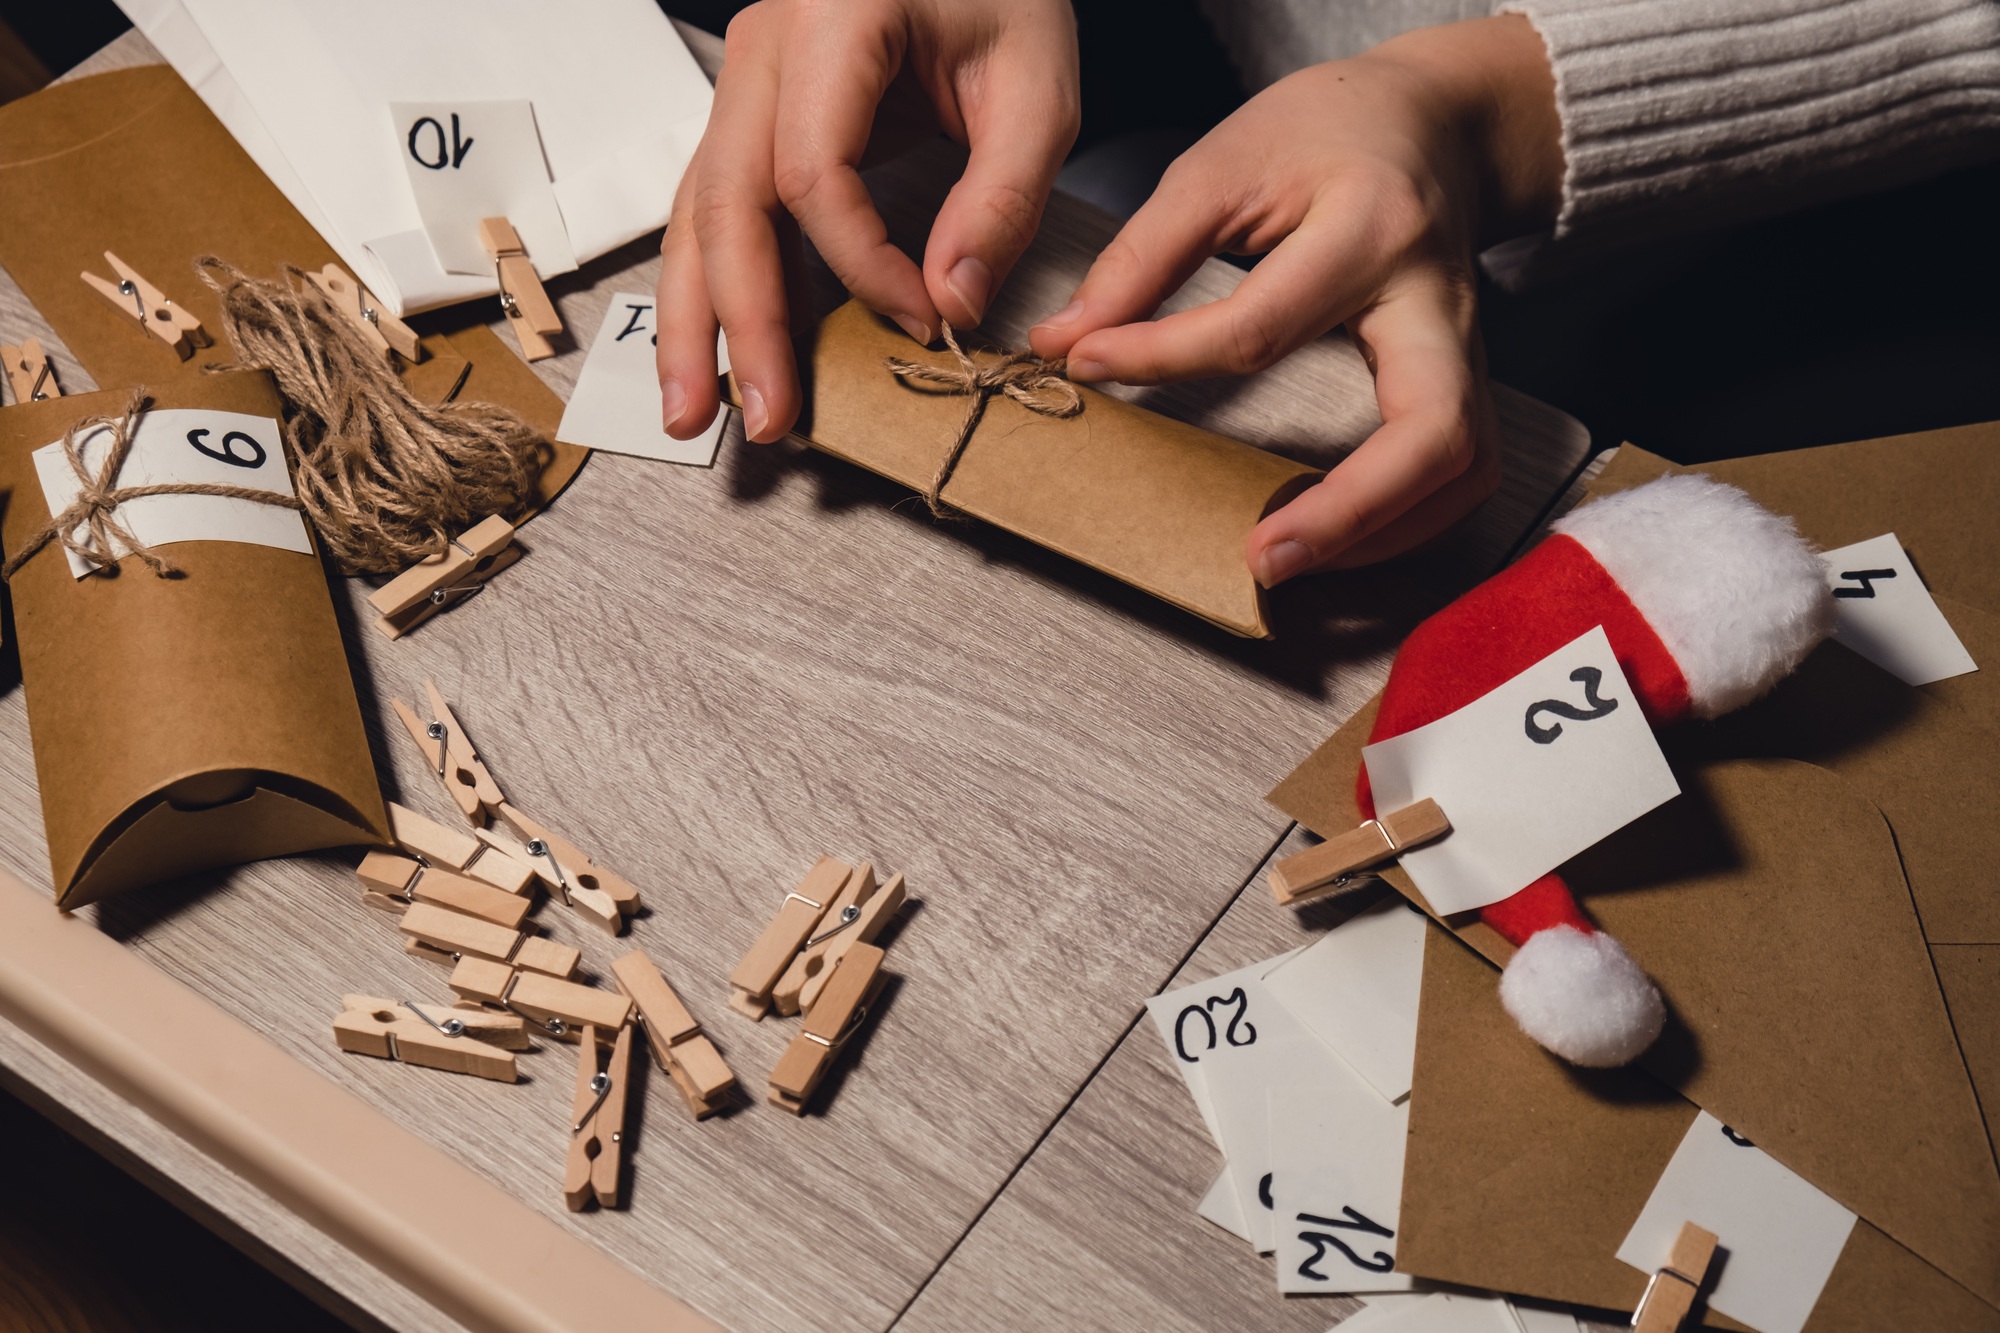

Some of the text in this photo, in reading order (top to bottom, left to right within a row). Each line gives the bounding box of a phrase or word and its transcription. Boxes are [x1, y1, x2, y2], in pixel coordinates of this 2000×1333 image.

[408, 113, 474, 170] 10
[615, 304, 657, 347] 1
[1831, 567, 1898, 599] 4
[1524, 666, 1619, 745] 2
[1174, 987, 1257, 1063] 20
[1296, 1205, 1396, 1281] 12
